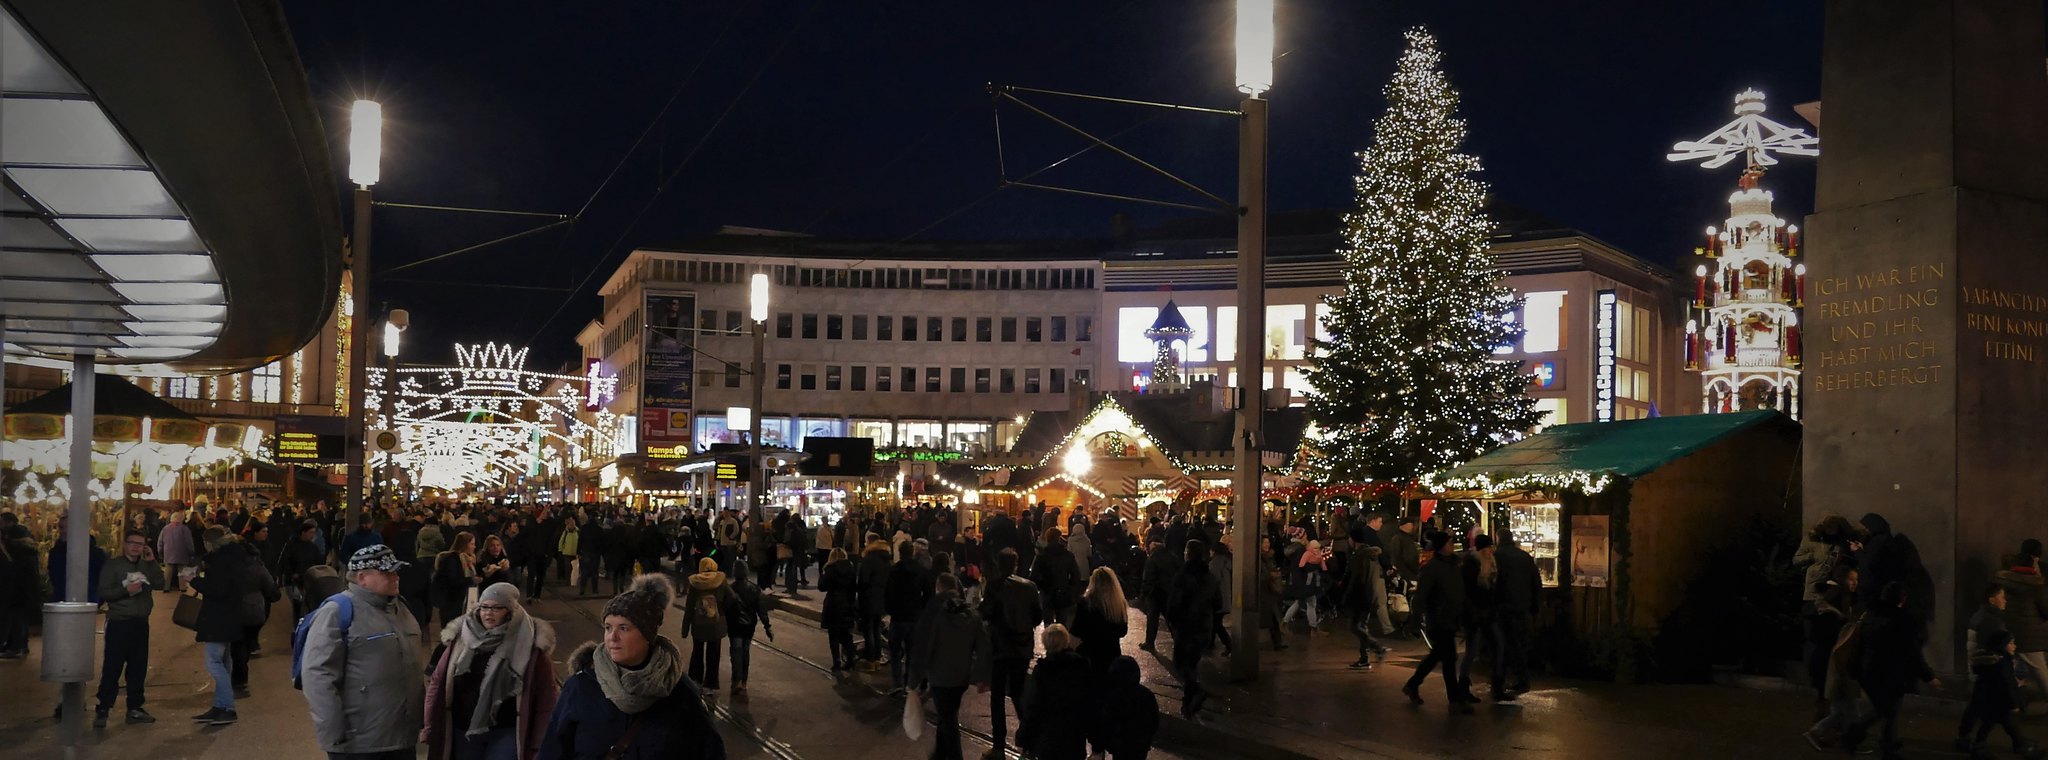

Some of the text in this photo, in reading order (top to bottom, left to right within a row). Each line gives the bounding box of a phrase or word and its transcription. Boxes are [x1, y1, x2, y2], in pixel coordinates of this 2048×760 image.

[1814, 261, 1945, 297] ICH WAR EIN
[1819, 287, 1939, 320] FREMDLING
[1830, 315, 1923, 342] UND IHR
[1819, 339, 1936, 369] HABT MICH
[1814, 364, 1943, 393] BEHERBERGT
[647, 446, 674, 455] Kamps
